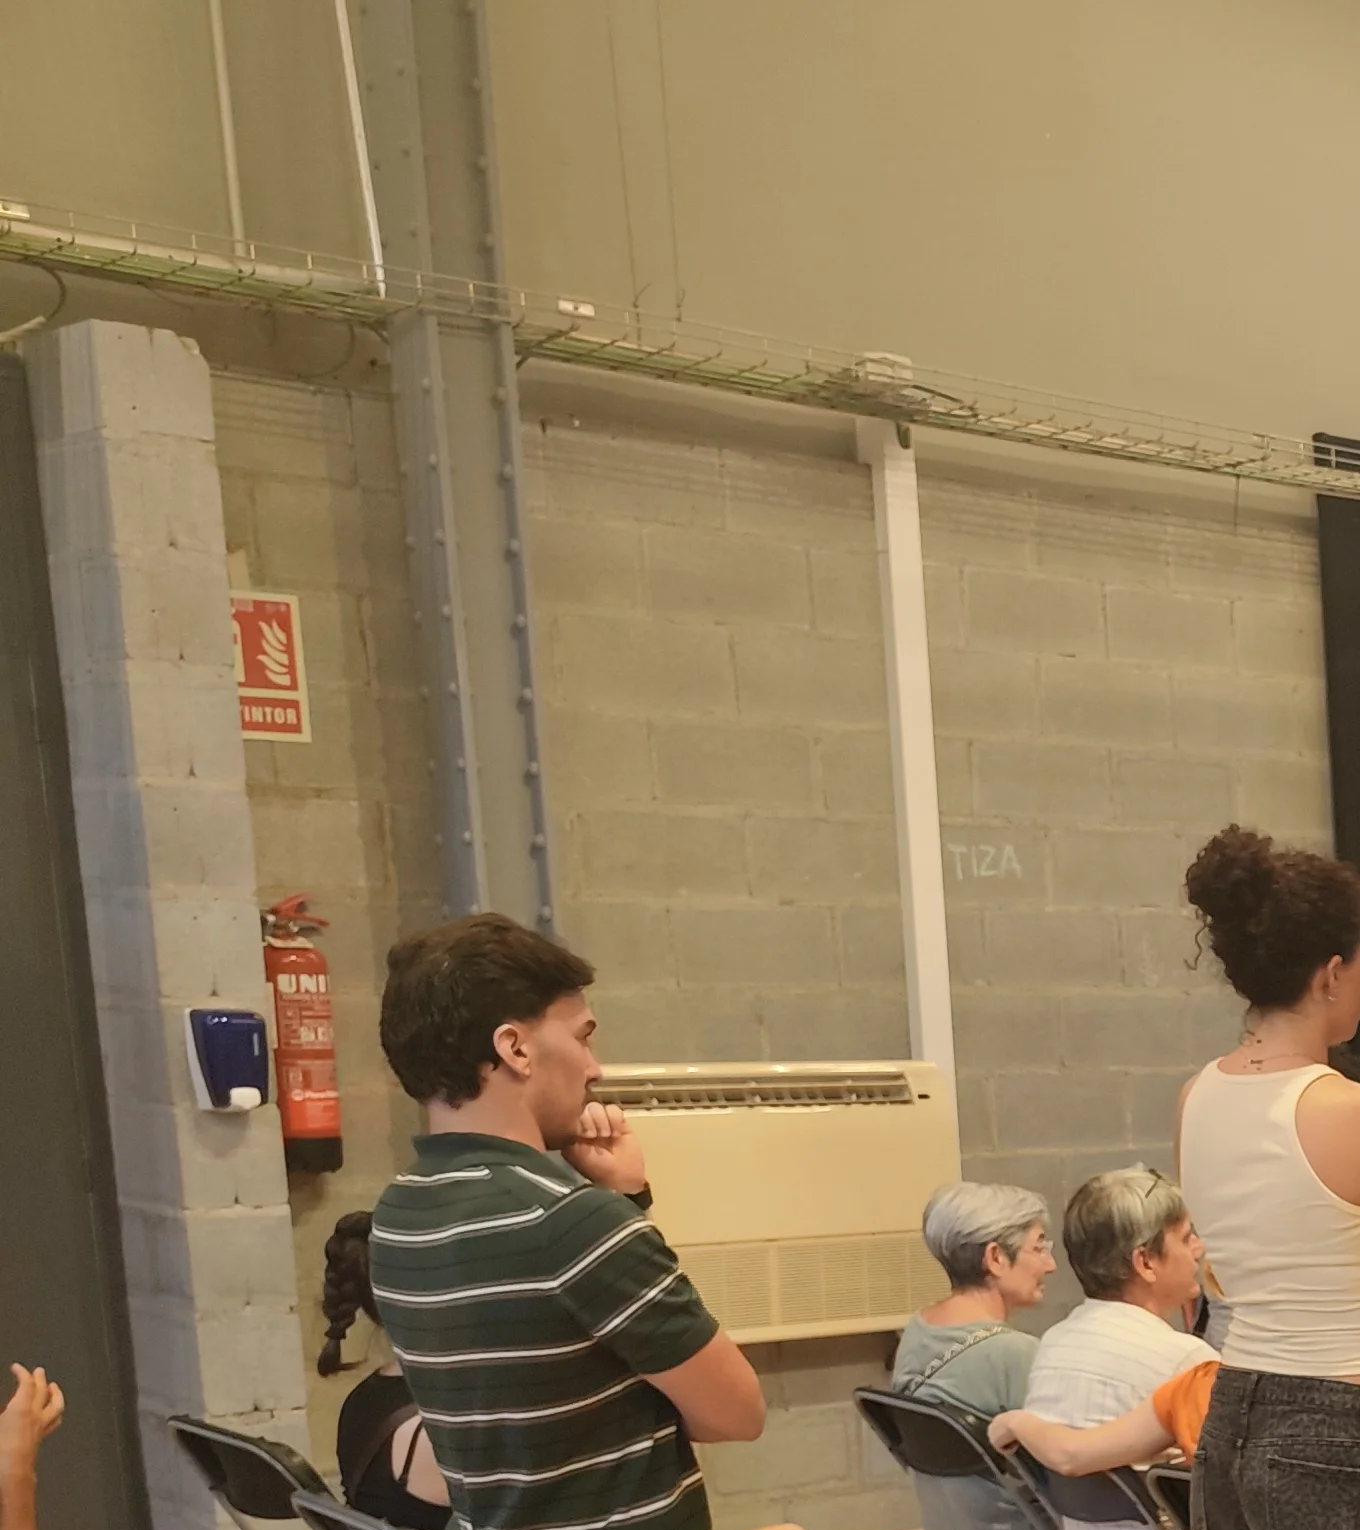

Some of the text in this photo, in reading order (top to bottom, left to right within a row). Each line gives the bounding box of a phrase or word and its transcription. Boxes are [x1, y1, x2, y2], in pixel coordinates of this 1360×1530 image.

[241, 704, 298, 725] INTOR
[947, 843, 1023, 881] TIZA
[276, 973, 330, 994] UNI
